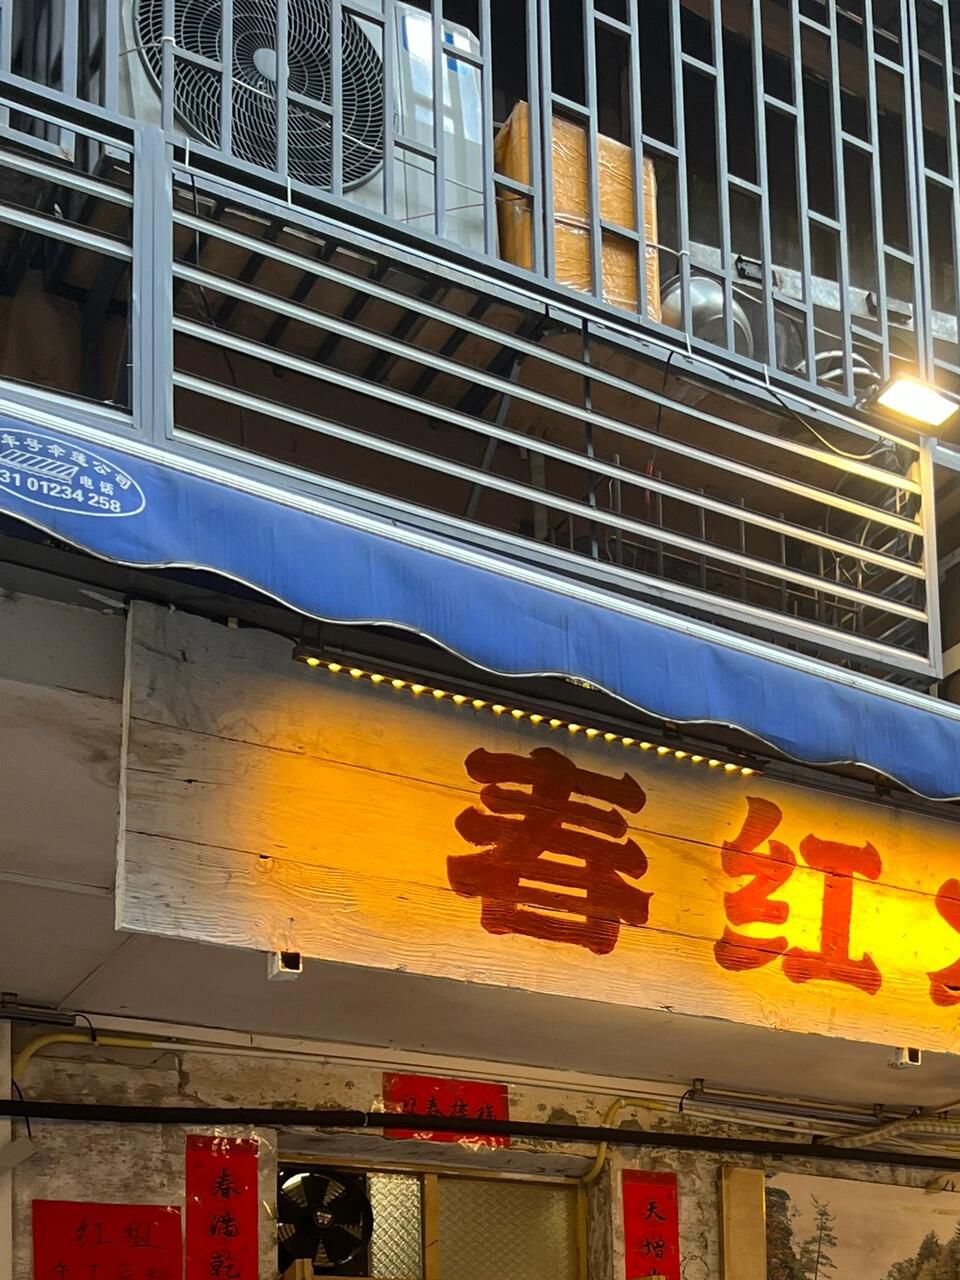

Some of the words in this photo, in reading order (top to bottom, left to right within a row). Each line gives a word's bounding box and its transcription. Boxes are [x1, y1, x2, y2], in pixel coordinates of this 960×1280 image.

[27, 477, 84, 503] 01234
[88, 492, 121, 512] 258
[79, 475, 114, 497] 电话
[643, 1199, 667, 1276] 天增
